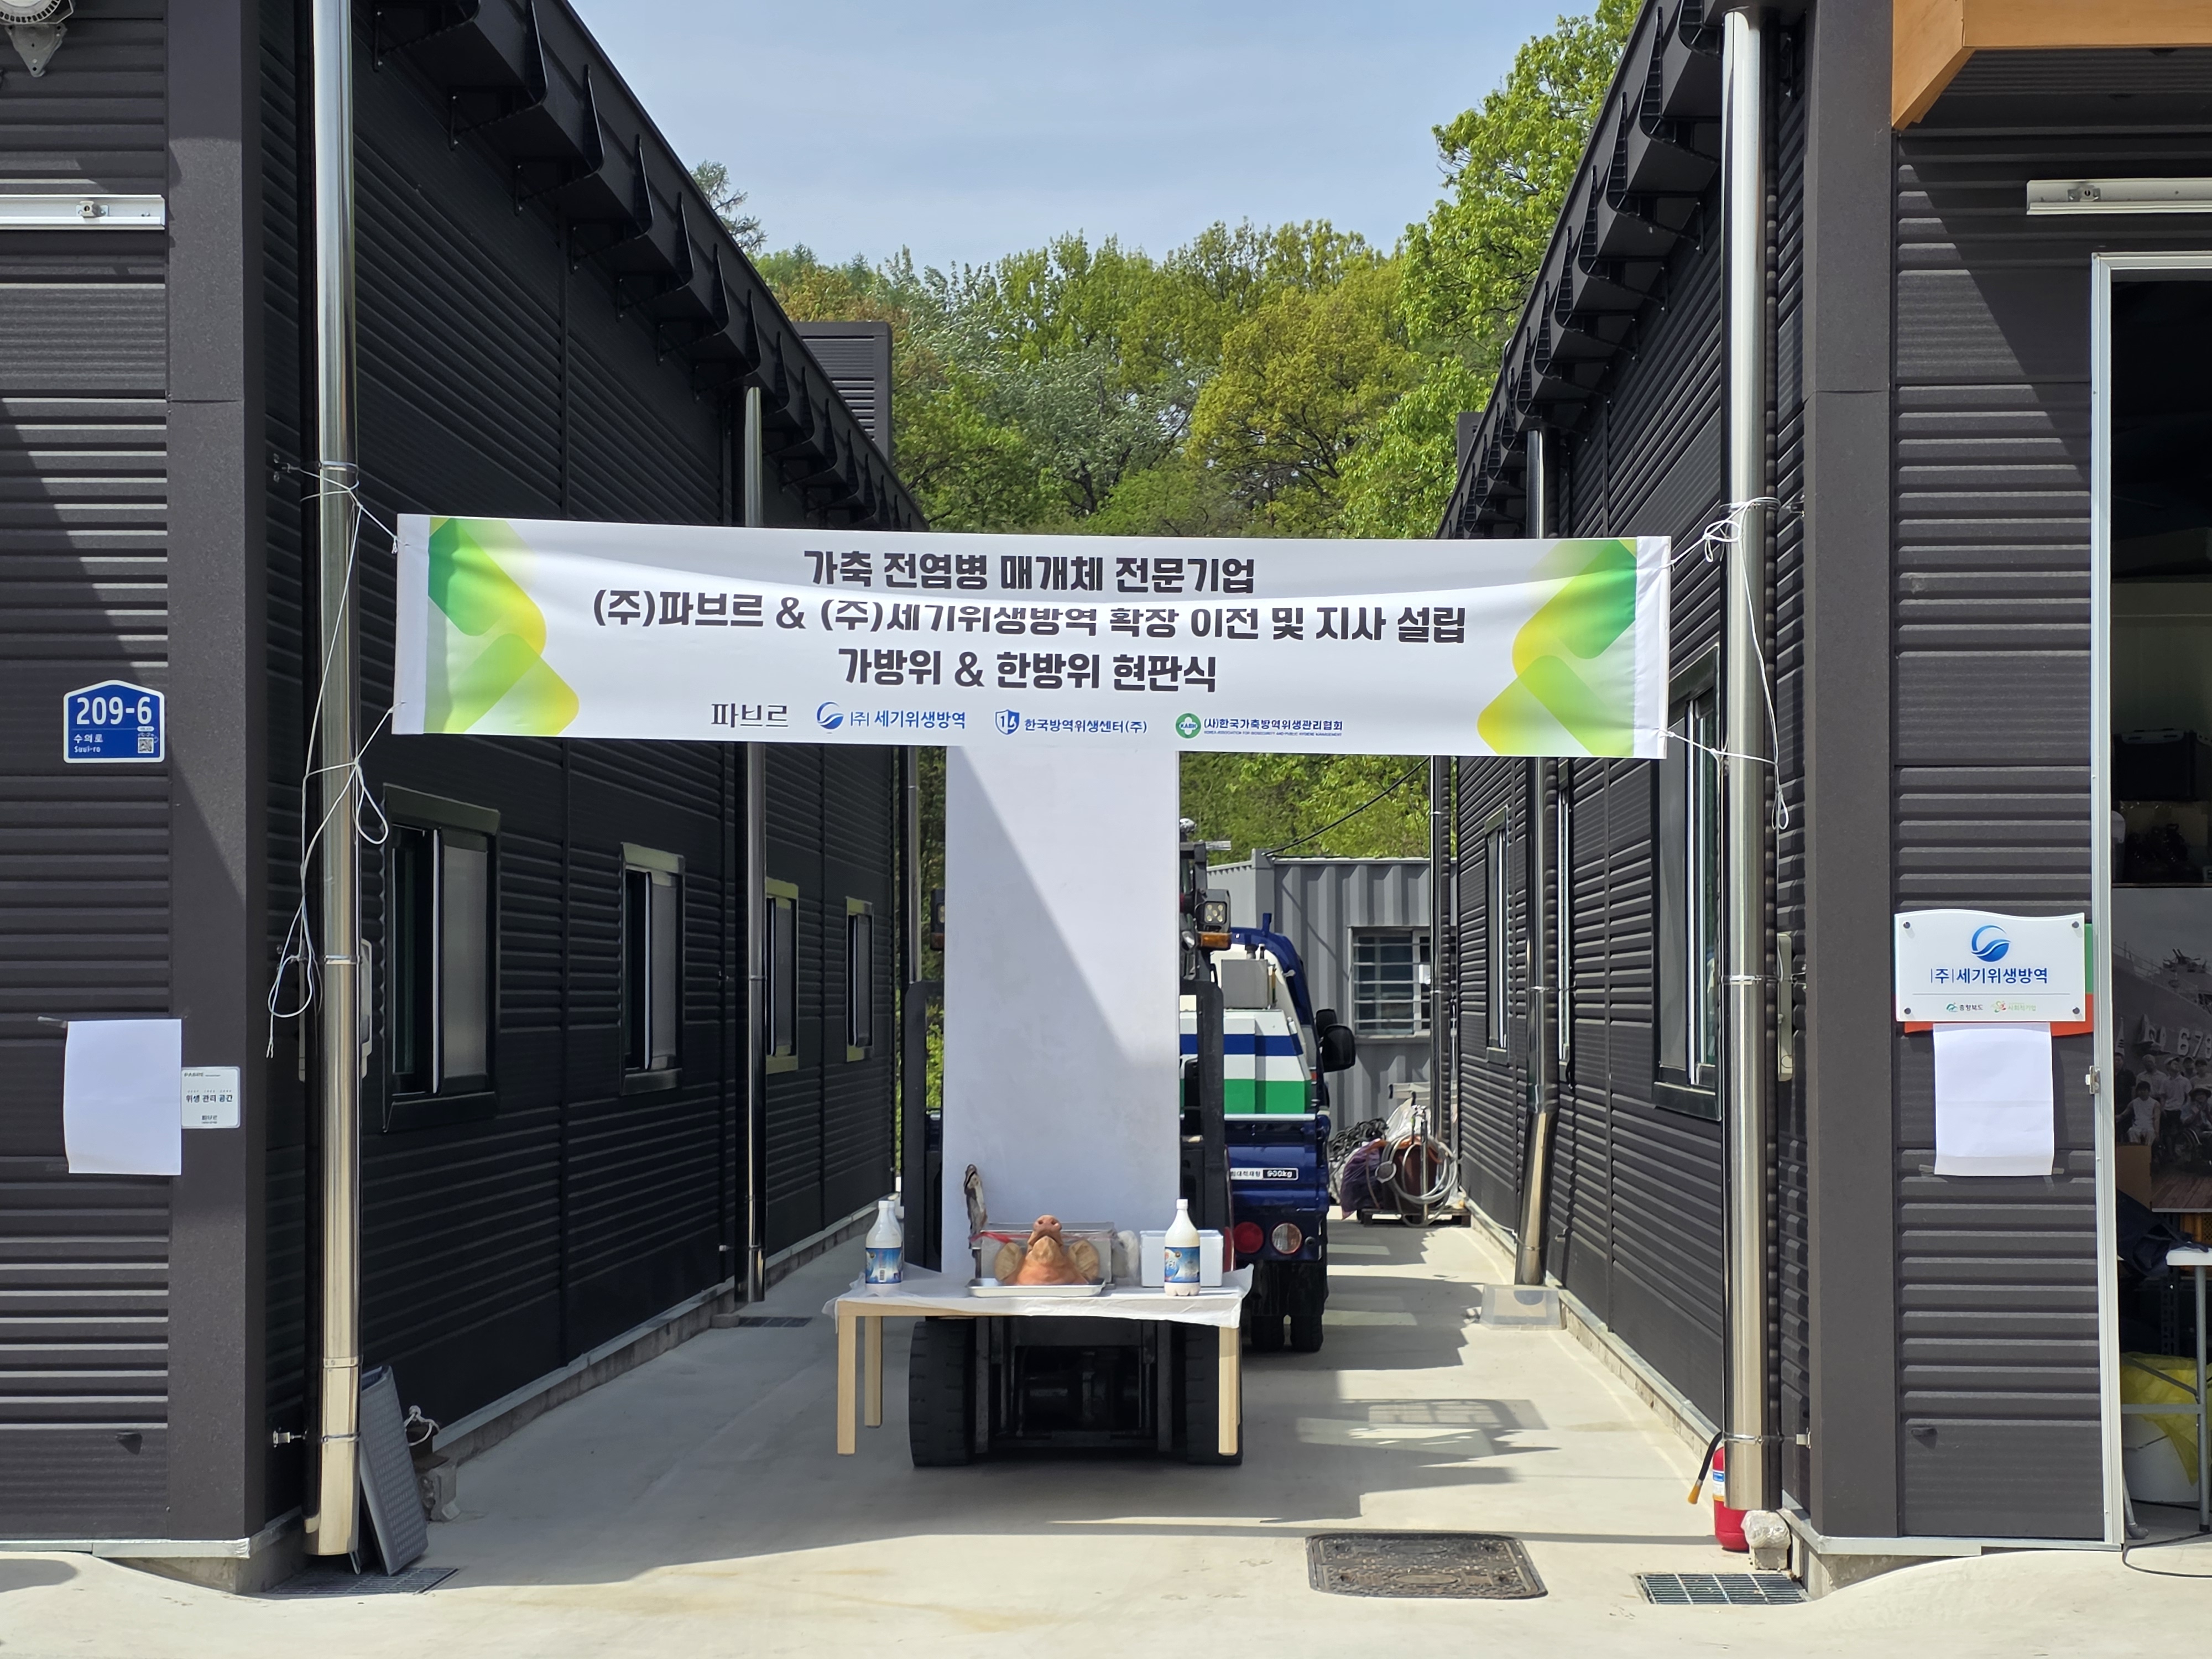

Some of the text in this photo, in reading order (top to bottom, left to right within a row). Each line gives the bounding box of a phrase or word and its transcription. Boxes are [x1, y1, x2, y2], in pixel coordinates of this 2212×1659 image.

[804, 550, 1254, 593] 가축 전염병 매개체 전문기업
[593, 589, 1465, 643] (주)파브르 & (주)세기위생방역 확장 이전 및 지사 설립
[839, 648, 1216, 692] 가방위 & 한방위 현판식
[76, 696, 152, 725] 209-6
[711, 702, 789, 728] 파브르
[874, 711, 966, 729] 세기위생방역
[74, 734, 103, 744] 수의로
[1024, 718, 1147, 733] 한국방역위생센터(주)
